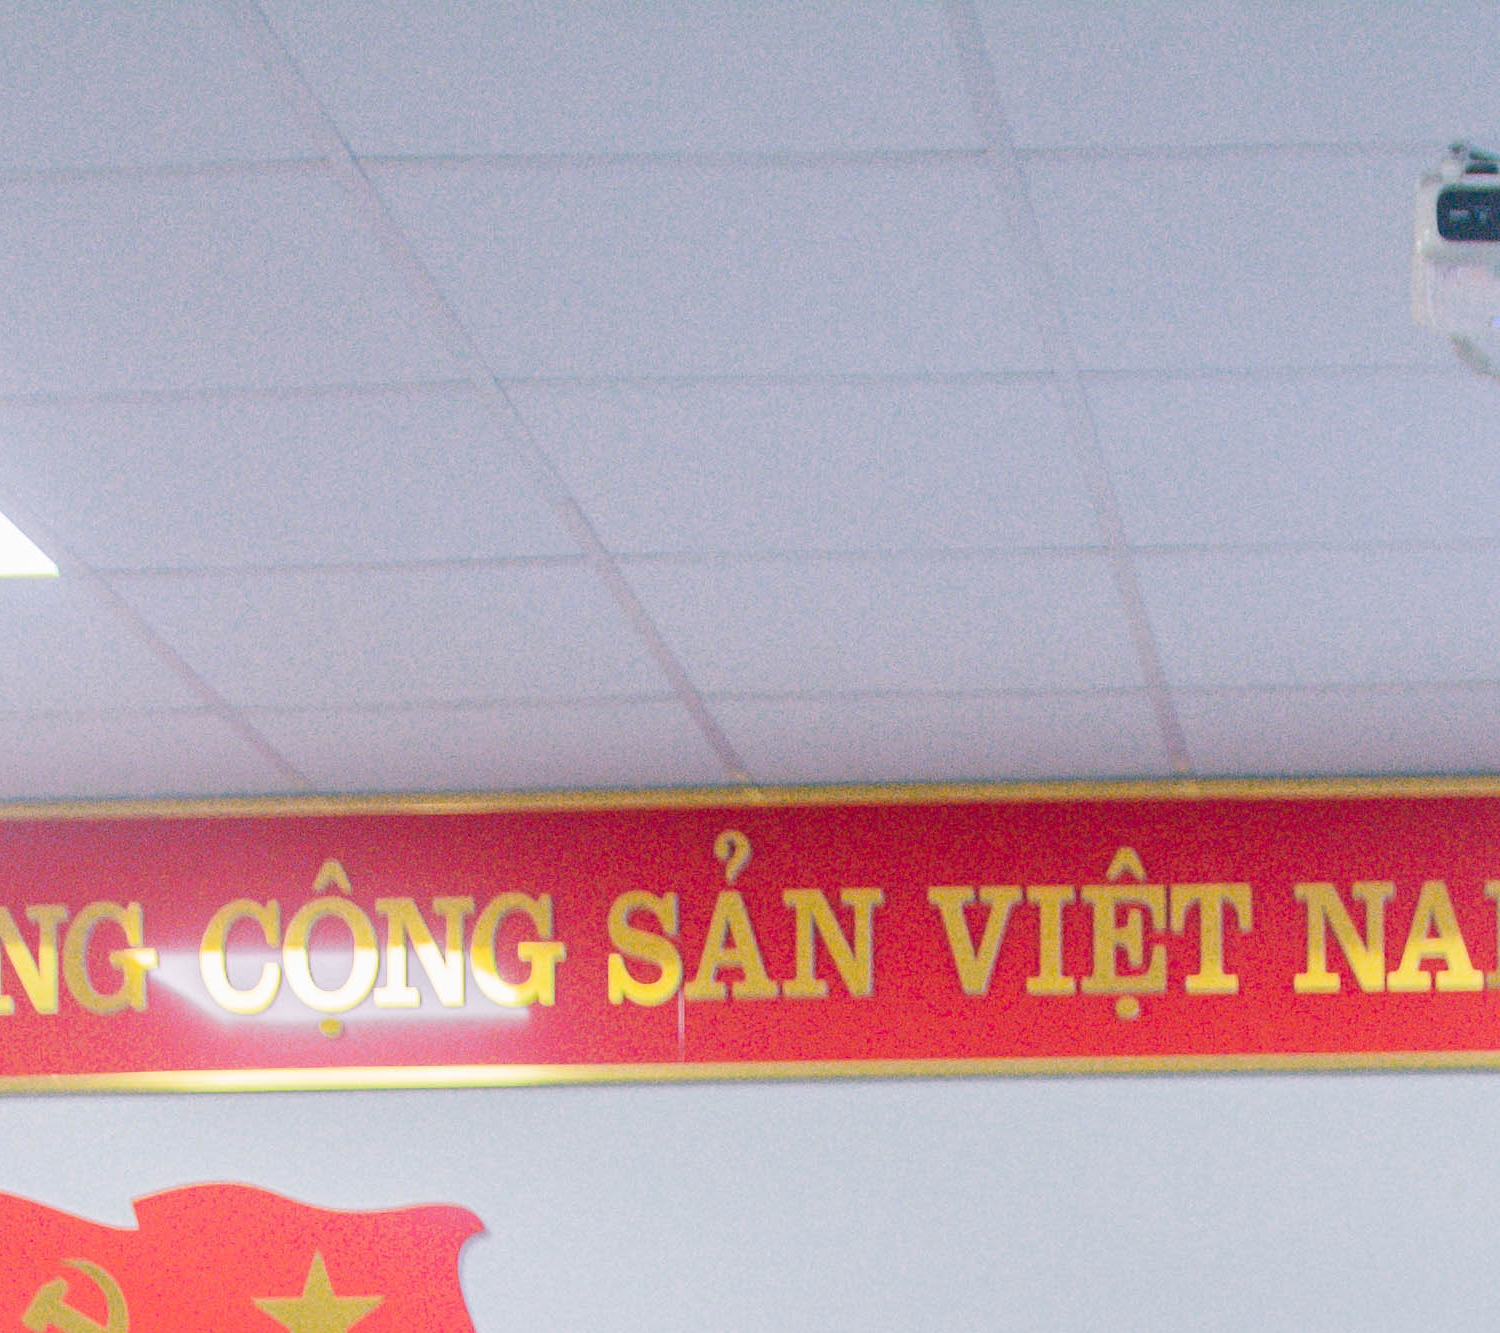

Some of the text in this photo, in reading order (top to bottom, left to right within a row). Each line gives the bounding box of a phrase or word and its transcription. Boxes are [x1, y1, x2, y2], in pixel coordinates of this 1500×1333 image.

[197, 857, 566, 1038] CỘNG
[606, 830, 885, 1007] SẢN
[928, 846, 1253, 1020] VIỆT
